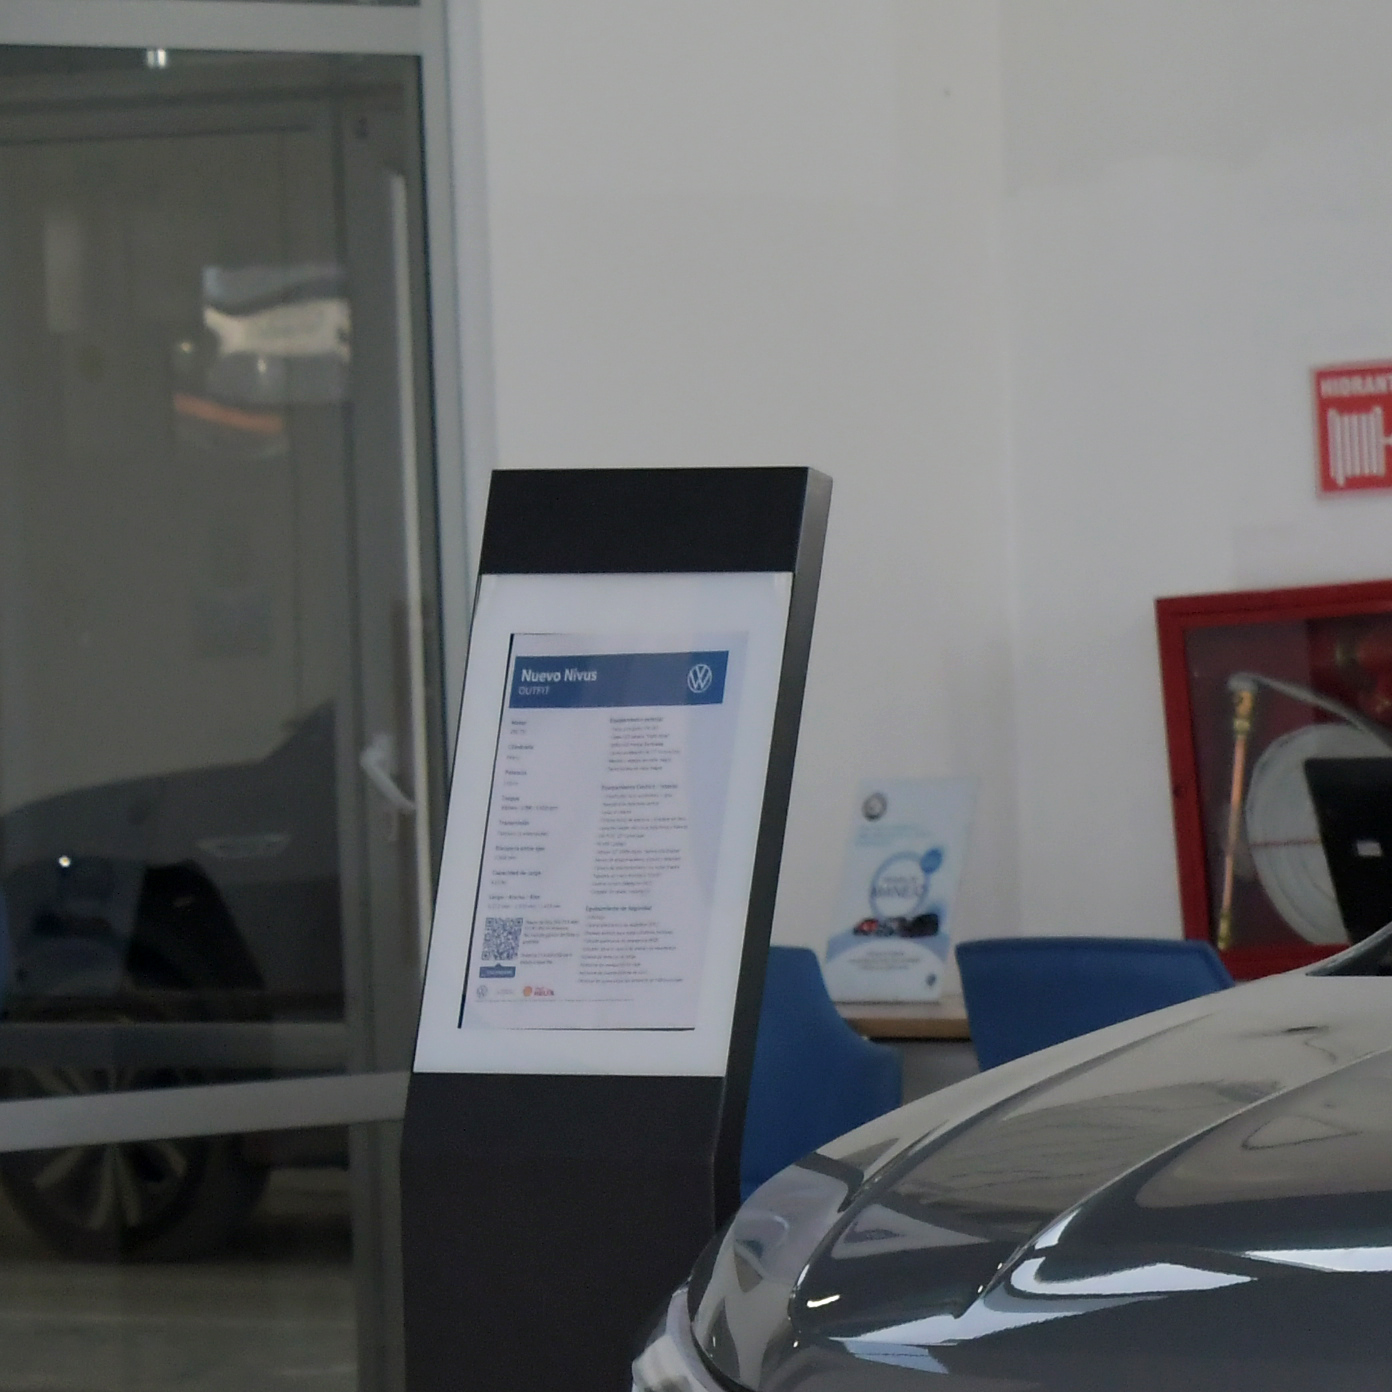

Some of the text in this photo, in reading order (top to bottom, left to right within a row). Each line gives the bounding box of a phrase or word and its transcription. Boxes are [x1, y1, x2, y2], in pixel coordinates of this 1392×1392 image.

[521, 668, 597, 683] Nuevo Nivus
[518, 686, 550, 696] OUTFIT
